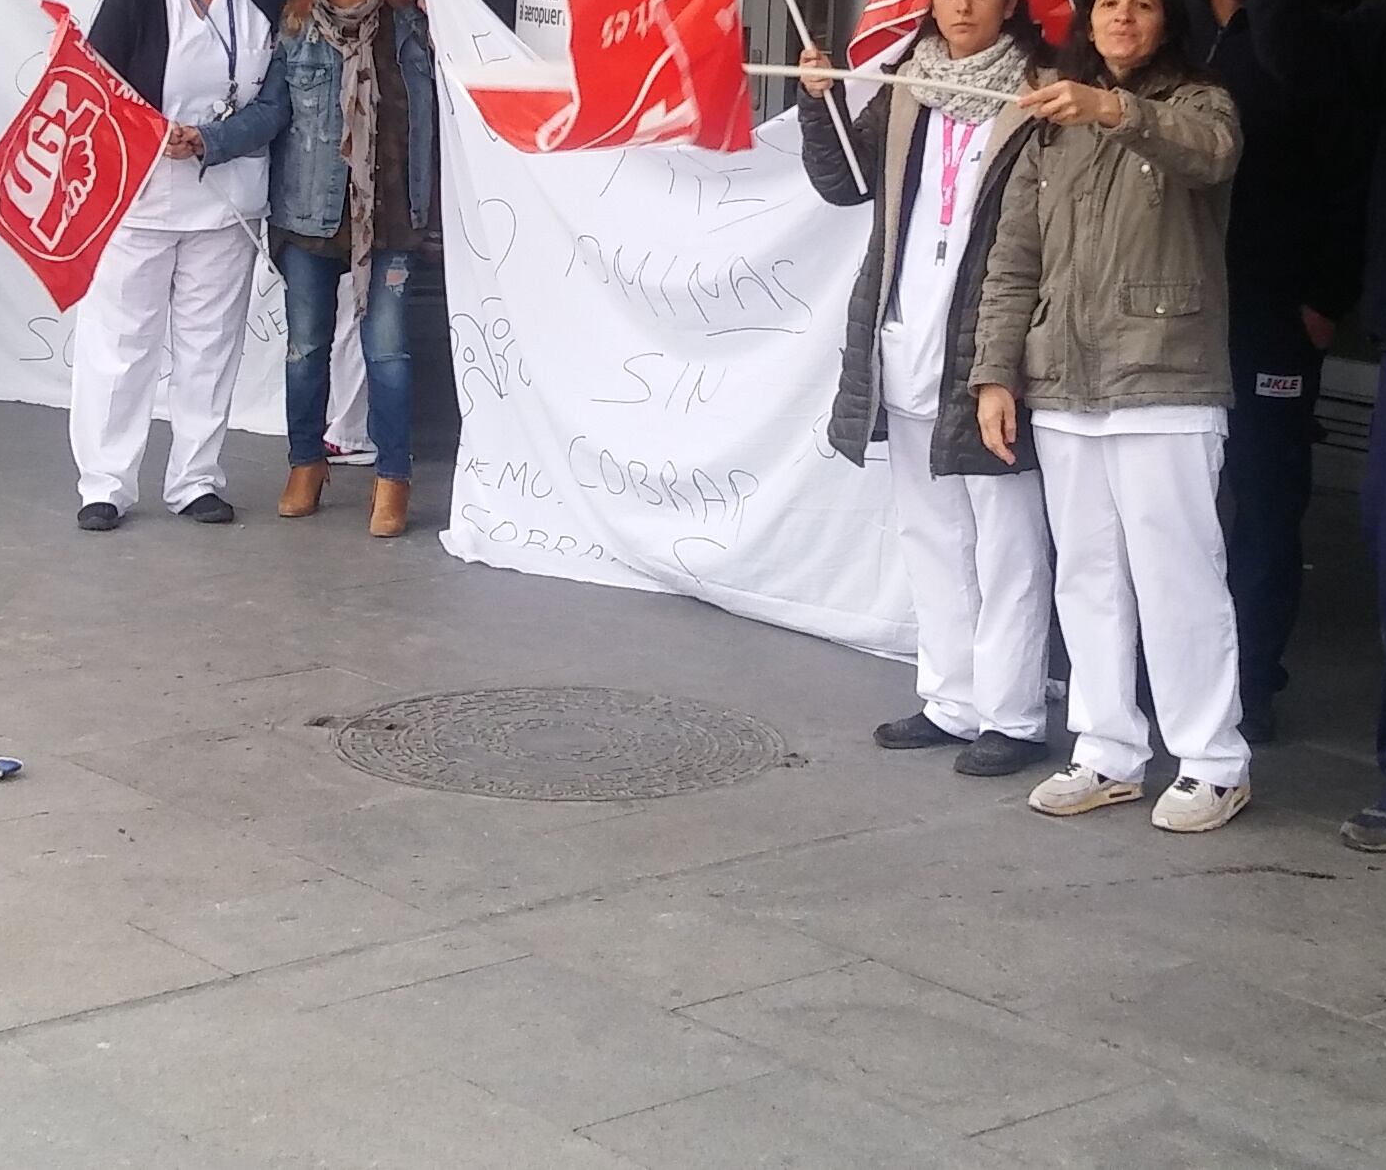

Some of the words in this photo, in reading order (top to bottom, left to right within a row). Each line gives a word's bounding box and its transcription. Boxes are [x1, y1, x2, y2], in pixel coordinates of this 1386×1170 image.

[524, 4, 566, 28] aeropuer
[3, 80, 75, 220] UGT
[589, 352, 728, 415] SIN
